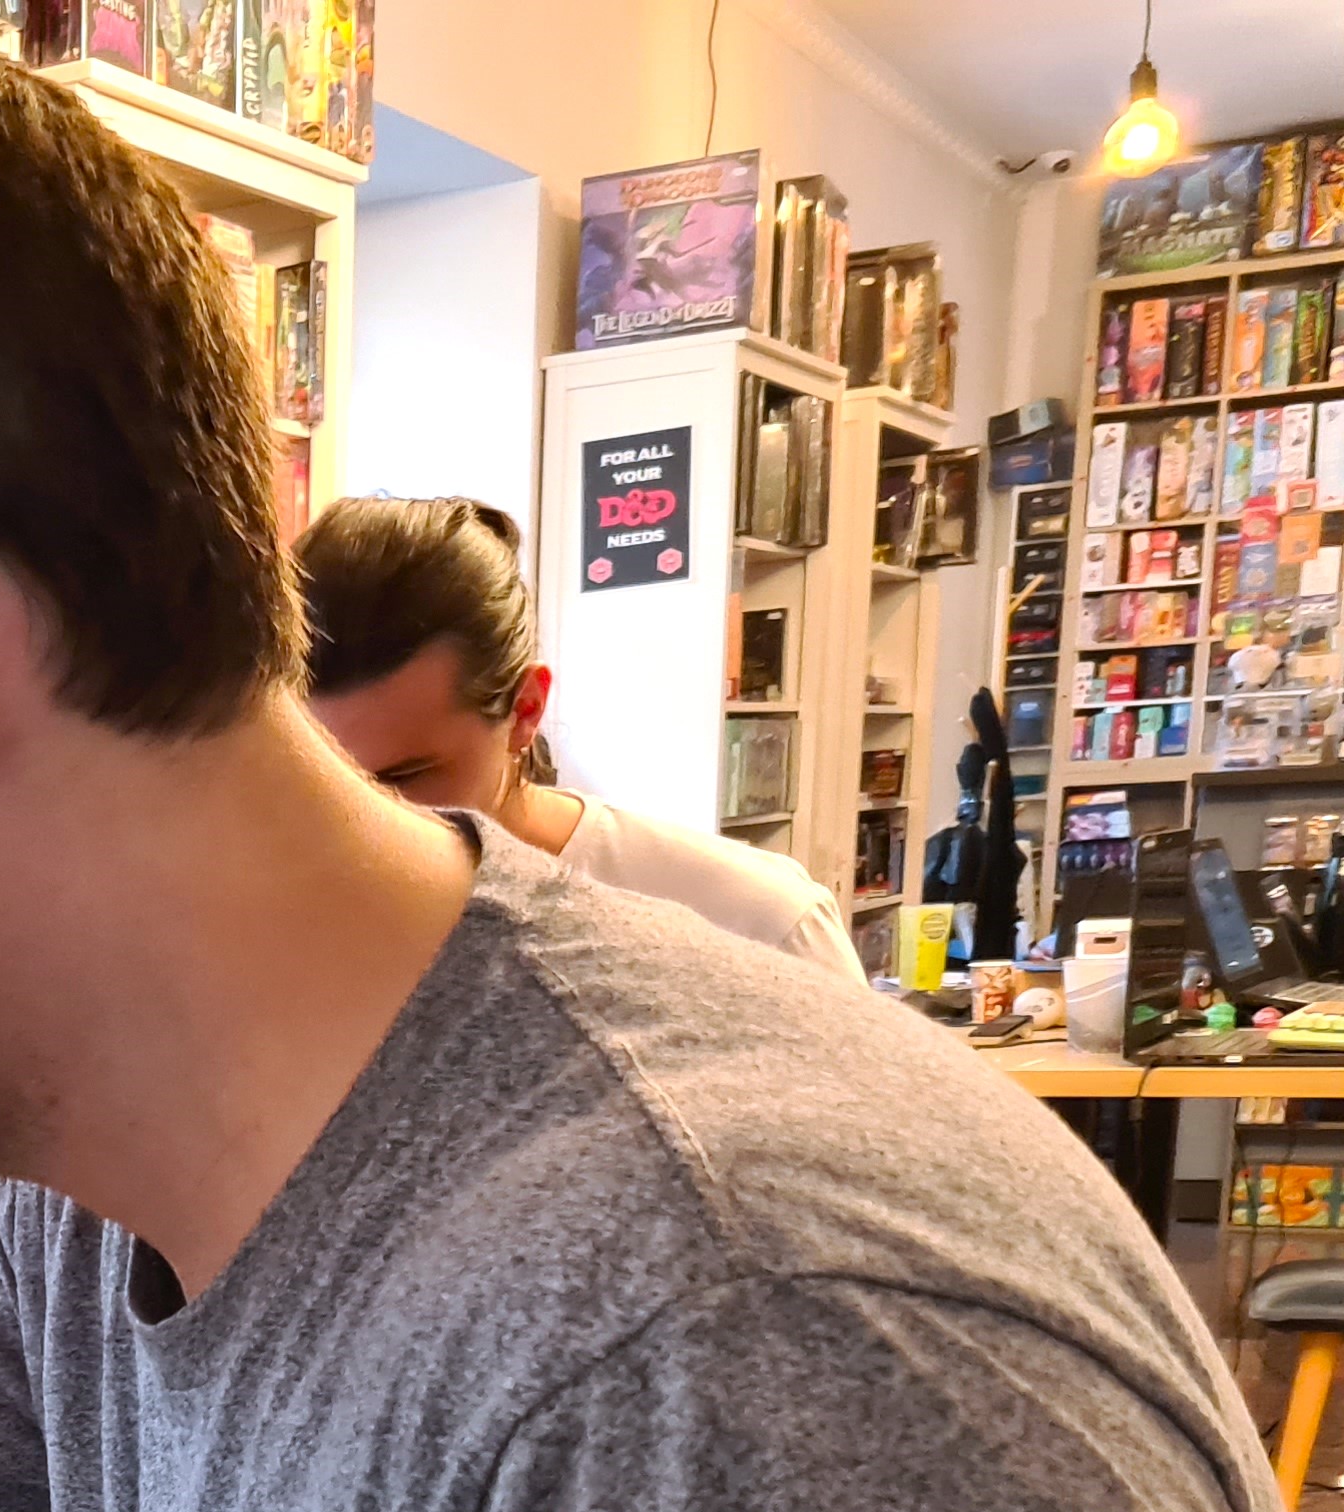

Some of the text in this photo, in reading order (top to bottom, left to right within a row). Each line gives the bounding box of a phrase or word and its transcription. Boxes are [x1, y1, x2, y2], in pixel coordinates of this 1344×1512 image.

[242, 37, 261, 115] CRYPTID
[600, 443, 675, 467] FOR ALL
[612, 465, 663, 486] YOUR
[597, 488, 677, 528] D&D
[606, 529, 667, 549] NEEDS
